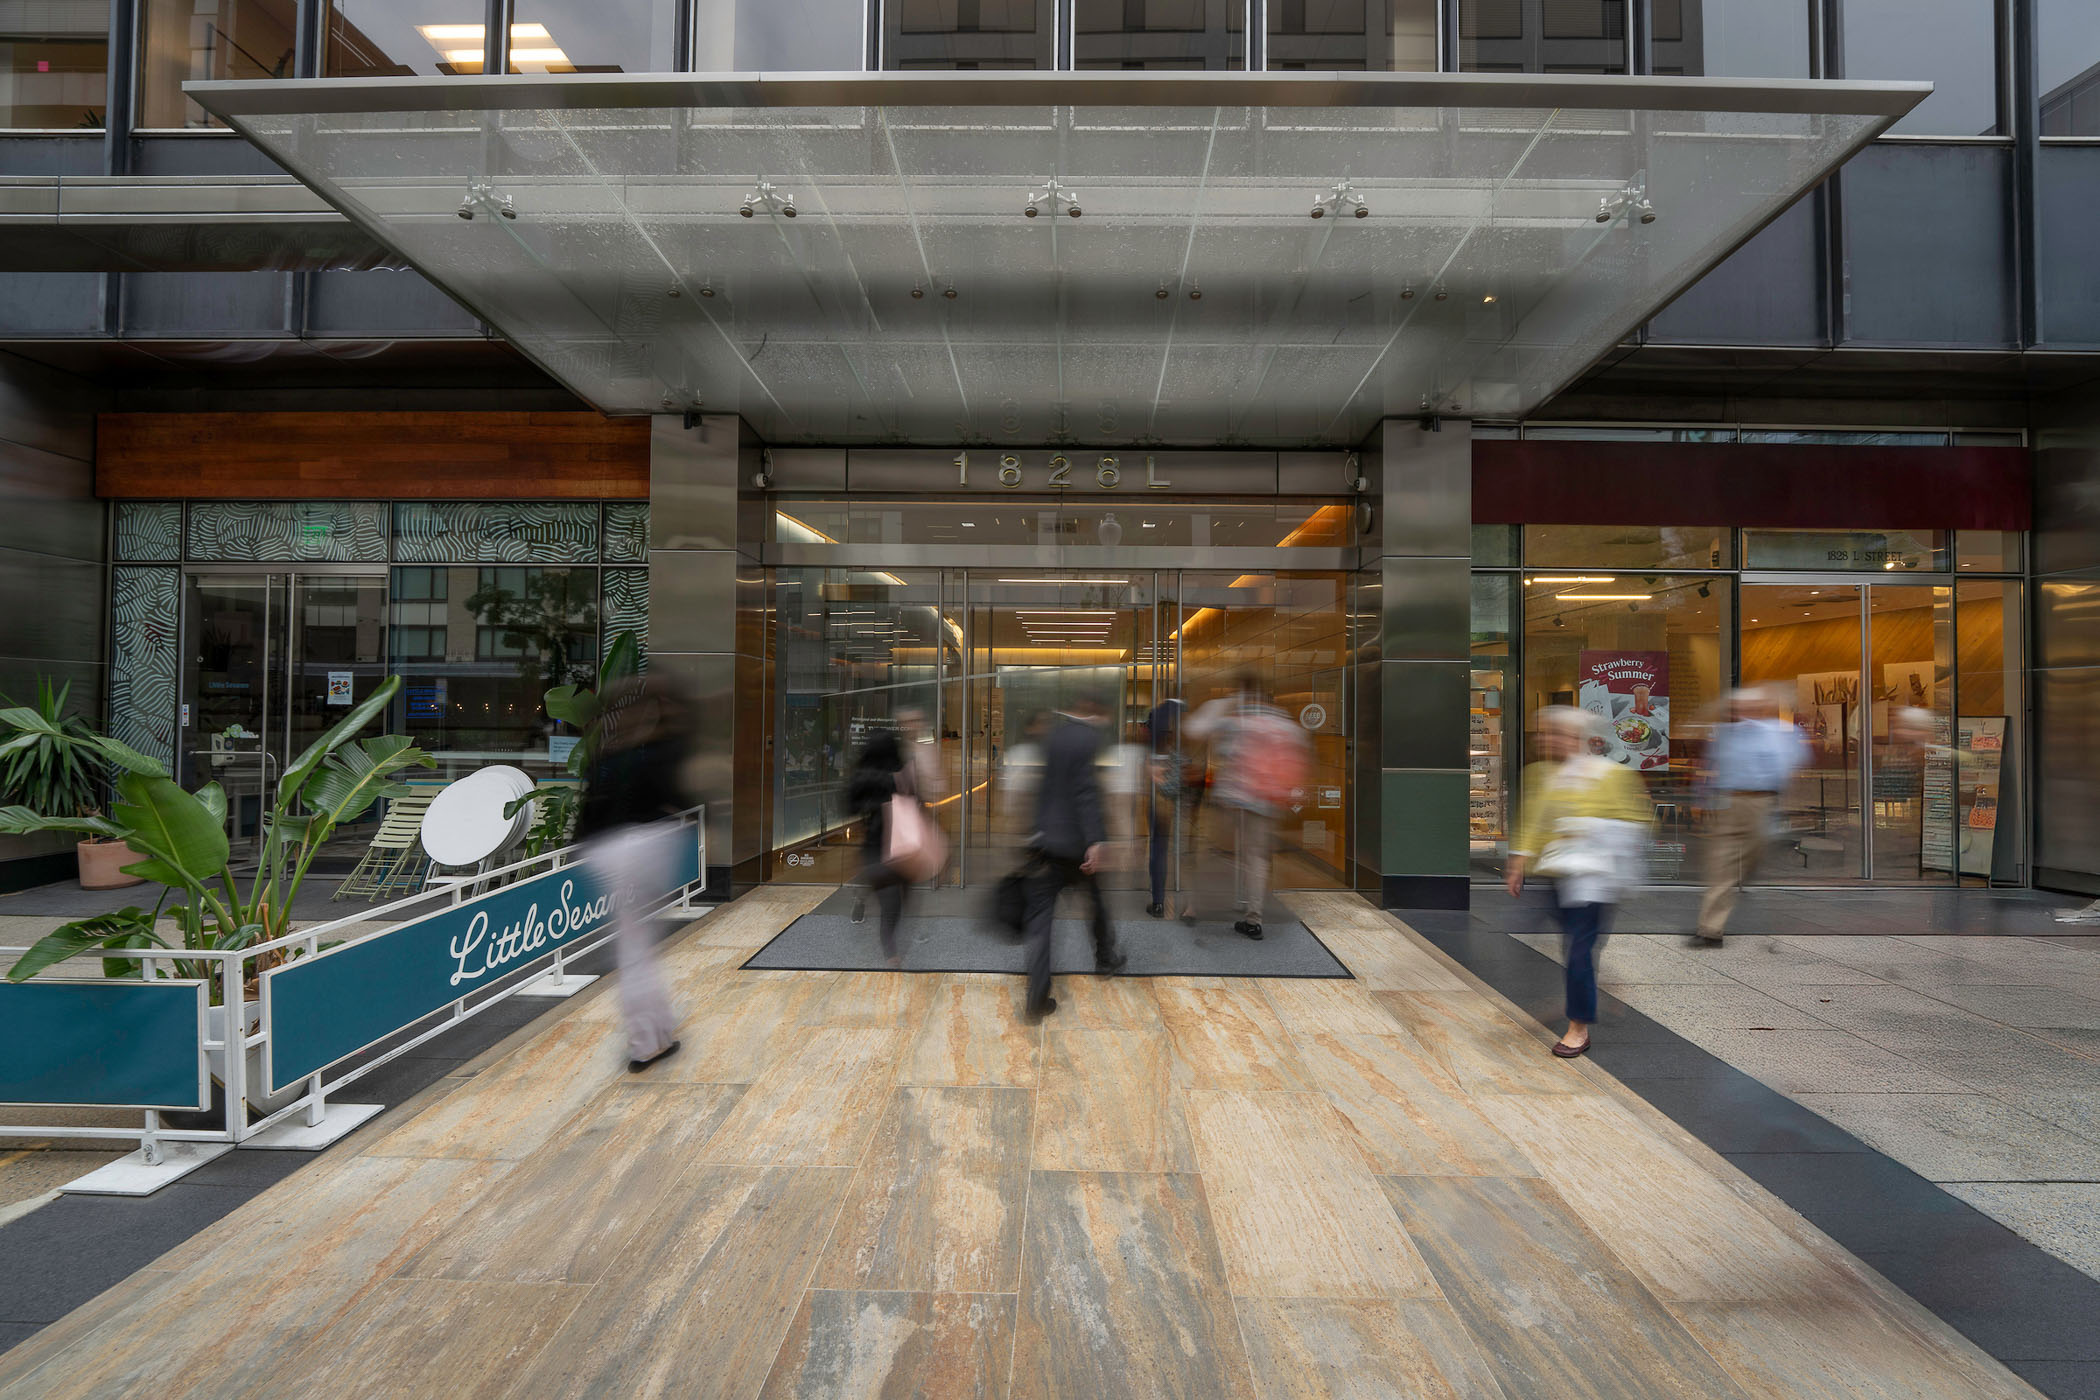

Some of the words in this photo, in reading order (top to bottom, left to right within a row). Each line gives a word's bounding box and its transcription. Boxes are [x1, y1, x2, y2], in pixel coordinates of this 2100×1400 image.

[953, 451, 1121, 488] 1828
[1147, 456, 1171, 488] L
[1828, 551, 1848, 560] 1828
[1853, 551, 1859, 560] L
[1865, 551, 1903, 561] STREET
[1591, 658, 1645, 675] Strawberry
[1607, 670, 1654, 681] Summer
[450, 902, 546, 986] Little
